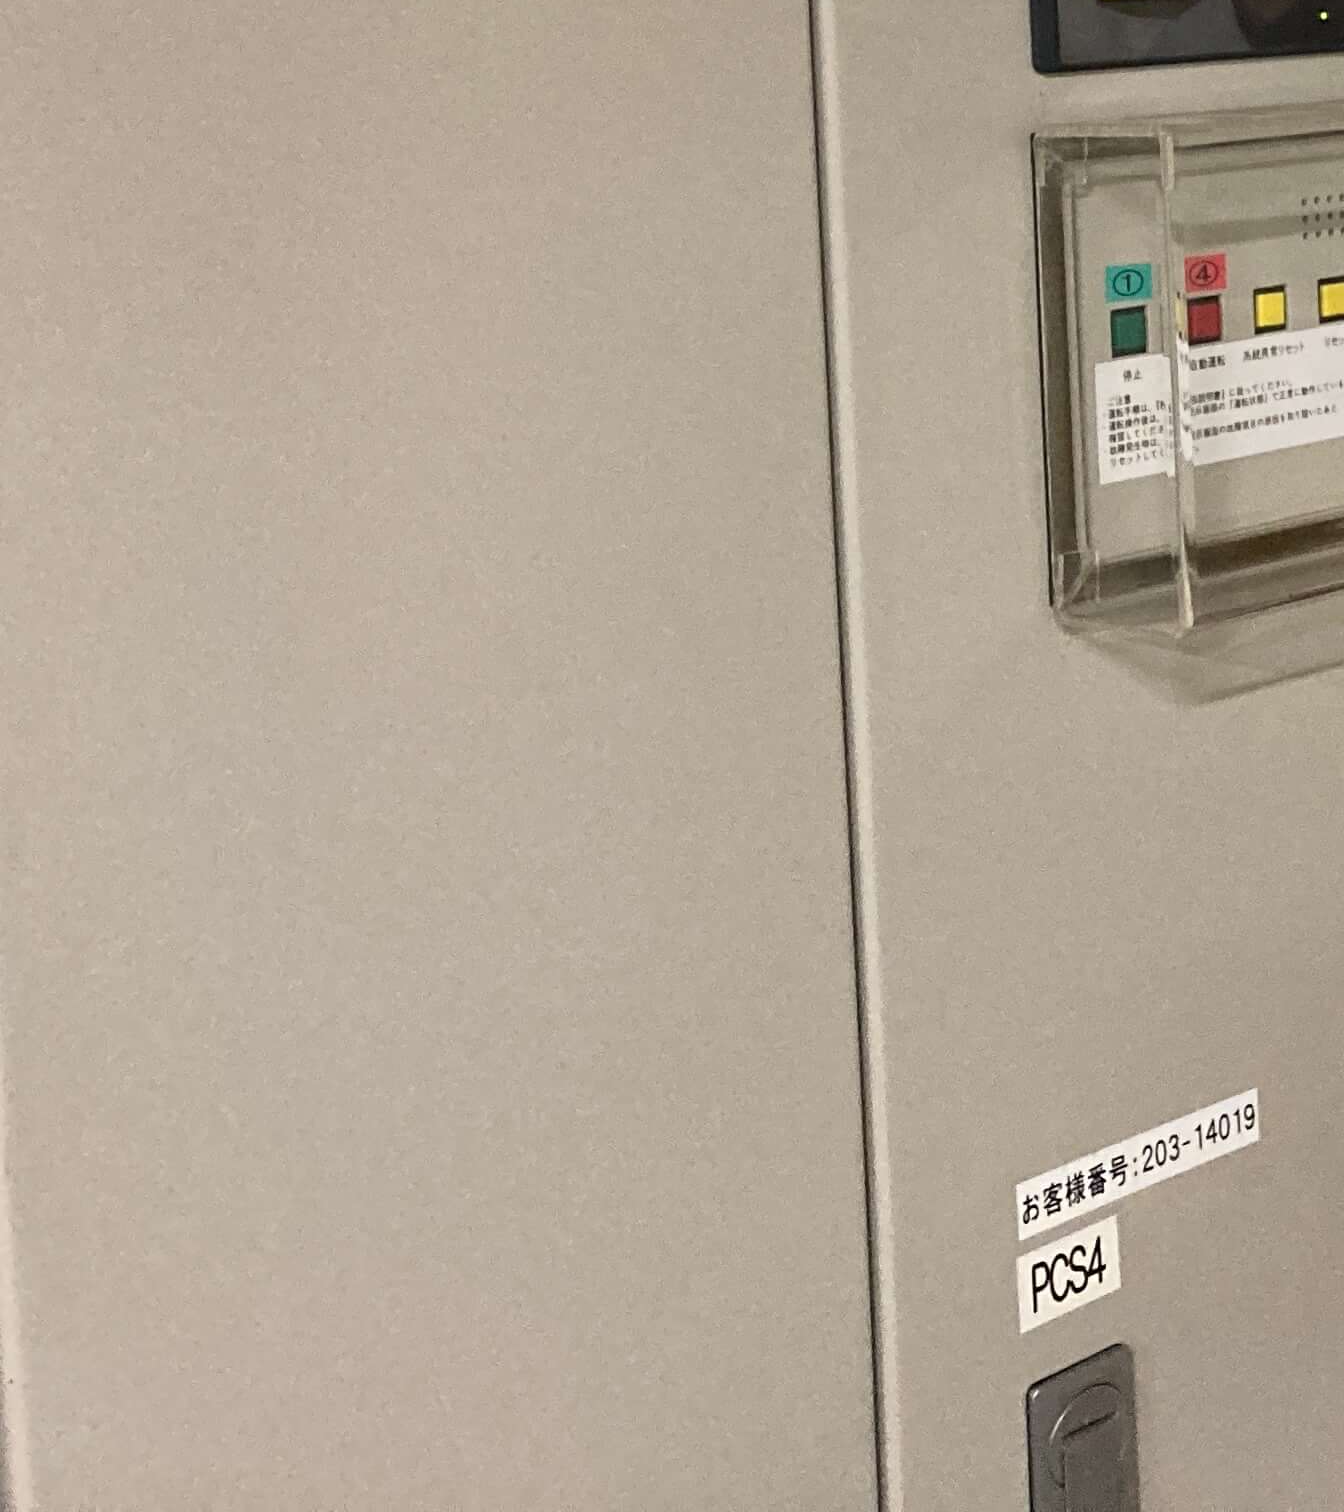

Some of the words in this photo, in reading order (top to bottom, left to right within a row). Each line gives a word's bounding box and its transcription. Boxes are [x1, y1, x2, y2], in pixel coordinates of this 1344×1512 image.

[1022, 1102, 1256, 1225] お客様番号:203-14019
[1031, 1235, 1107, 1314] PCS4
